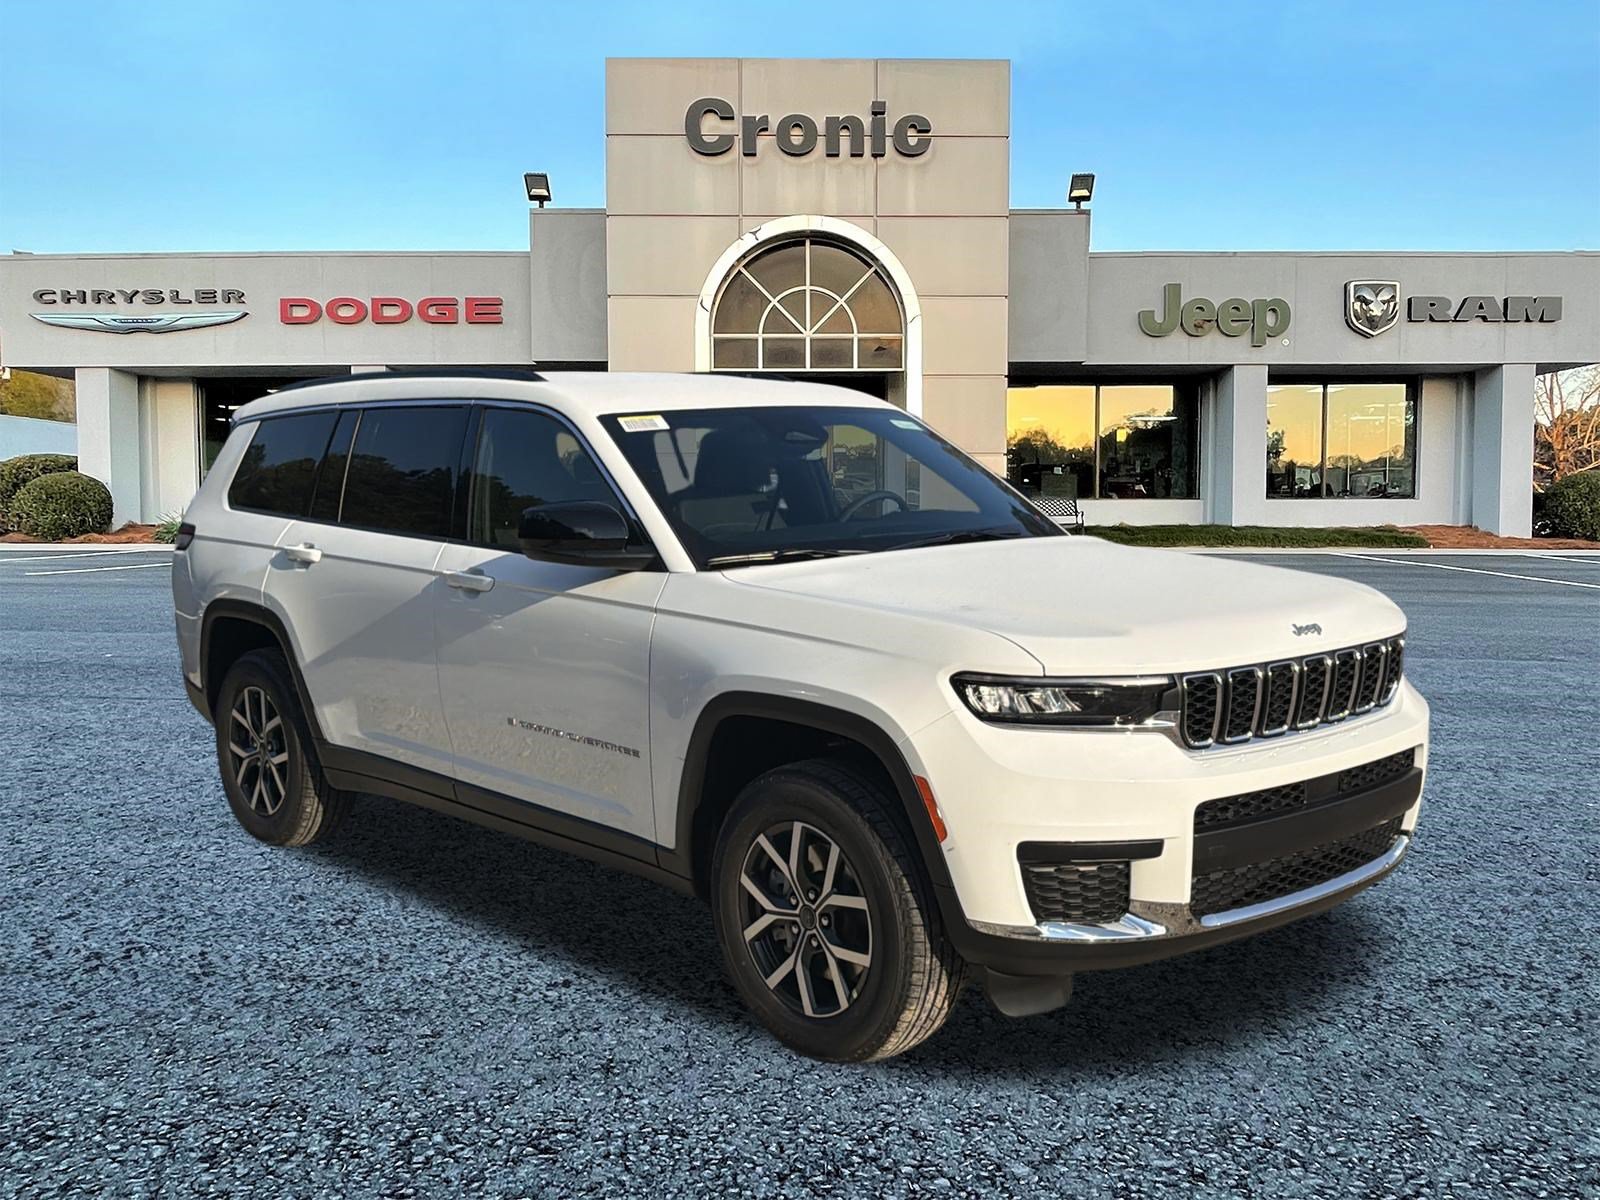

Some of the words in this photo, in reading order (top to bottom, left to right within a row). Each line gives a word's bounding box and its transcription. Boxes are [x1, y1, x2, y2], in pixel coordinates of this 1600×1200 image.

[685, 97, 932, 157] Cronic
[32, 289, 247, 304] CHRYSLER
[1407, 296, 1563, 322] RAM
[279, 297, 503, 324] DODGE
[1138, 283, 1291, 347] Jeep
[1292, 623, 1322, 637] Jeep
